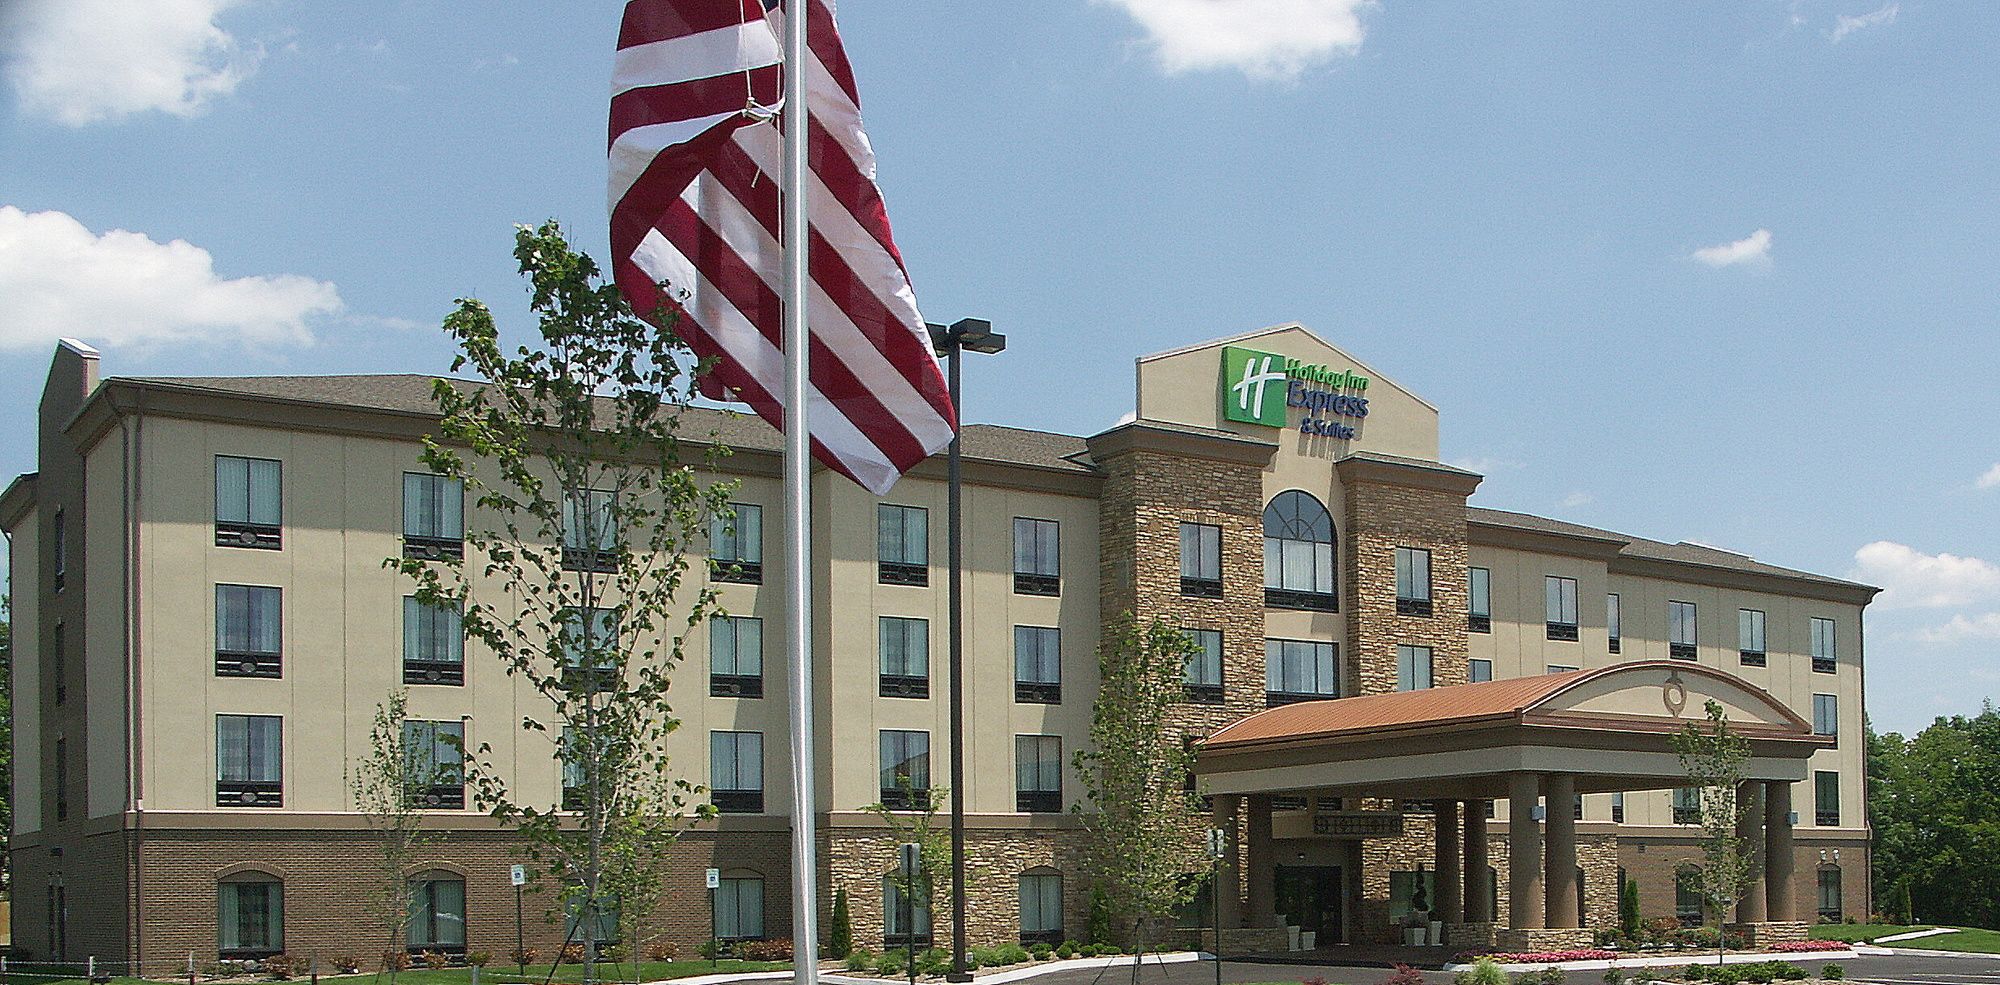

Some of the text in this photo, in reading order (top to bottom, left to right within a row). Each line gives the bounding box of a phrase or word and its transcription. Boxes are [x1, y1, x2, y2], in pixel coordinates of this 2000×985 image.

[1285, 358, 1369, 391] Holiday Inn
[1287, 380, 1370, 419] Express
[1301, 417, 1354, 440] & Suites
